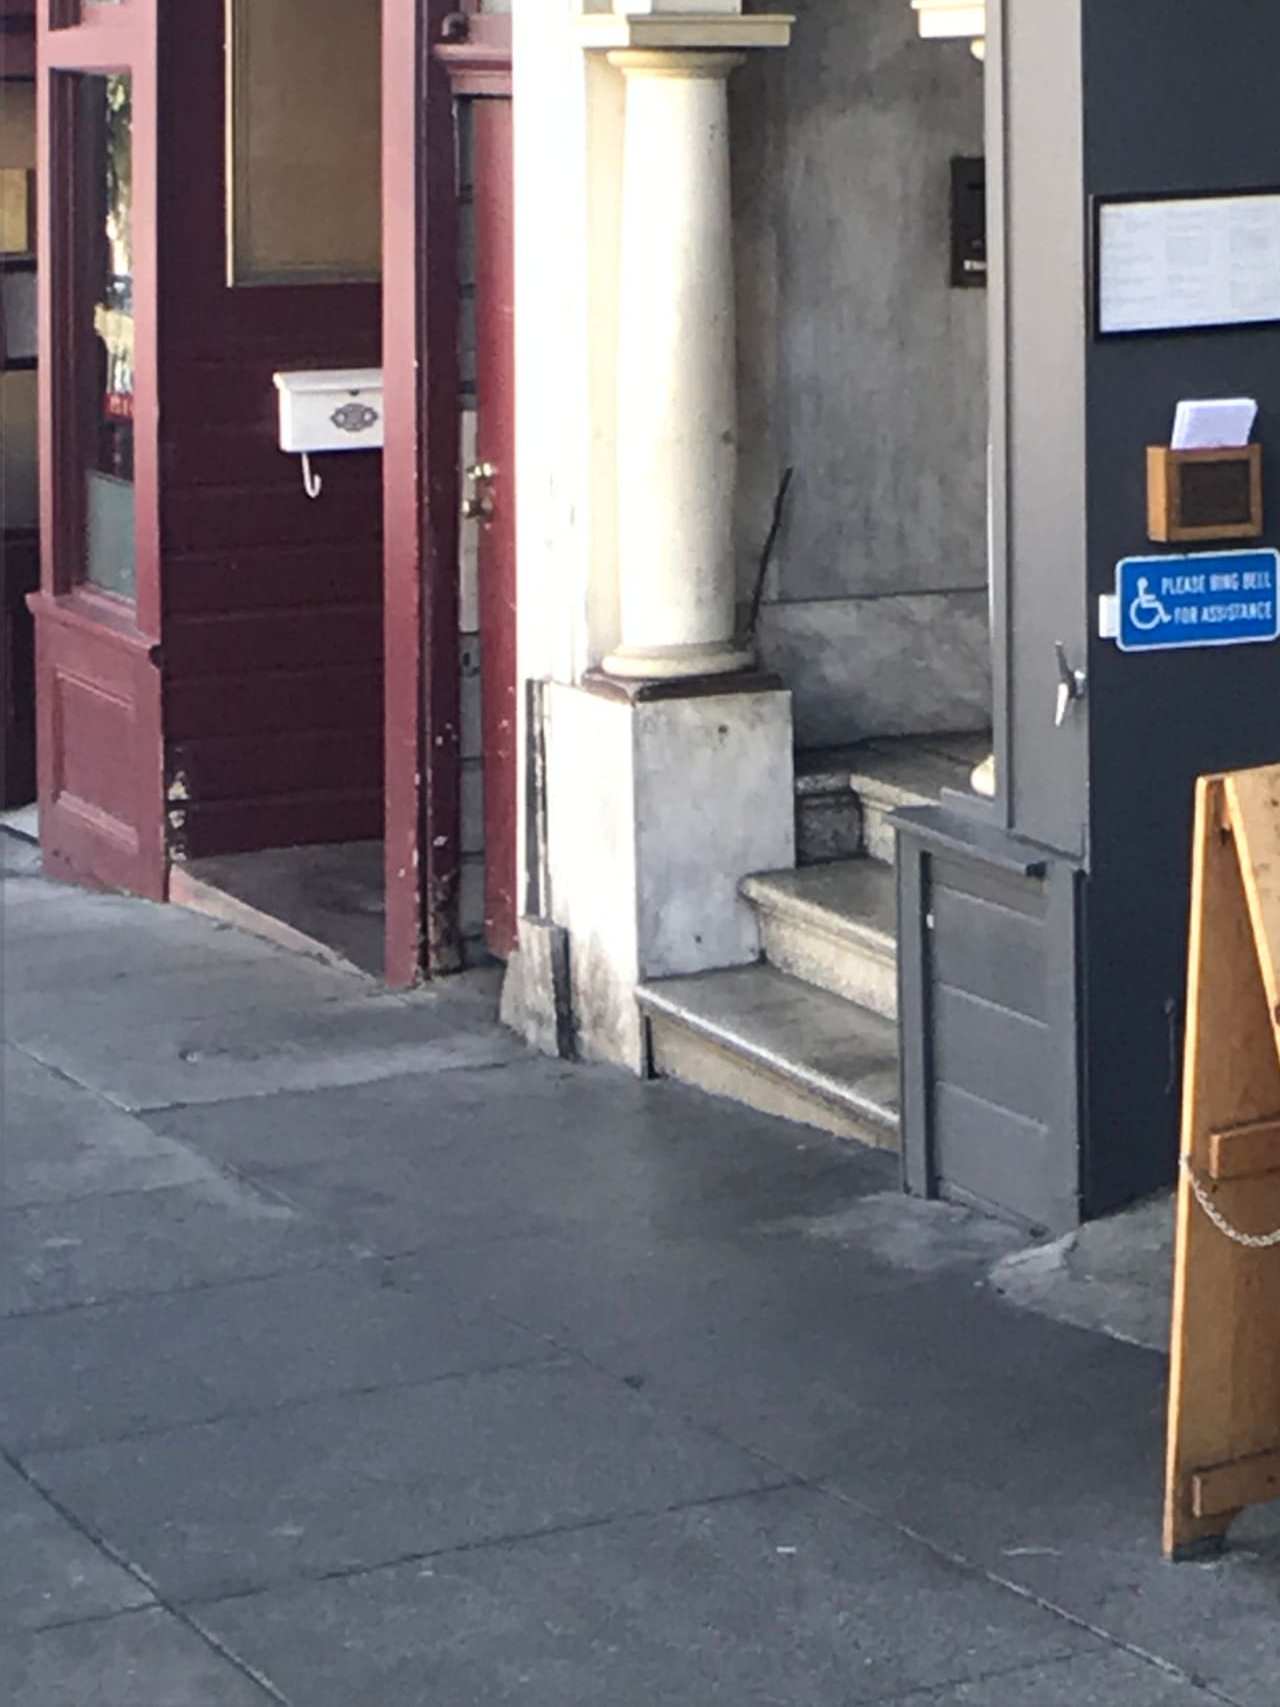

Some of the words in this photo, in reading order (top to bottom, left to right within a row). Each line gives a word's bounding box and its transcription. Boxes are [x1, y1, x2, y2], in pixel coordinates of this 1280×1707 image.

[1161, 574, 1206, 596] PLEASE
[1209, 571, 1239, 592] RING
[1242, 571, 1273, 591] BELL
[1174, 606, 1198, 625] FOR
[1201, 600, 1273, 624] ASSISTANCE
